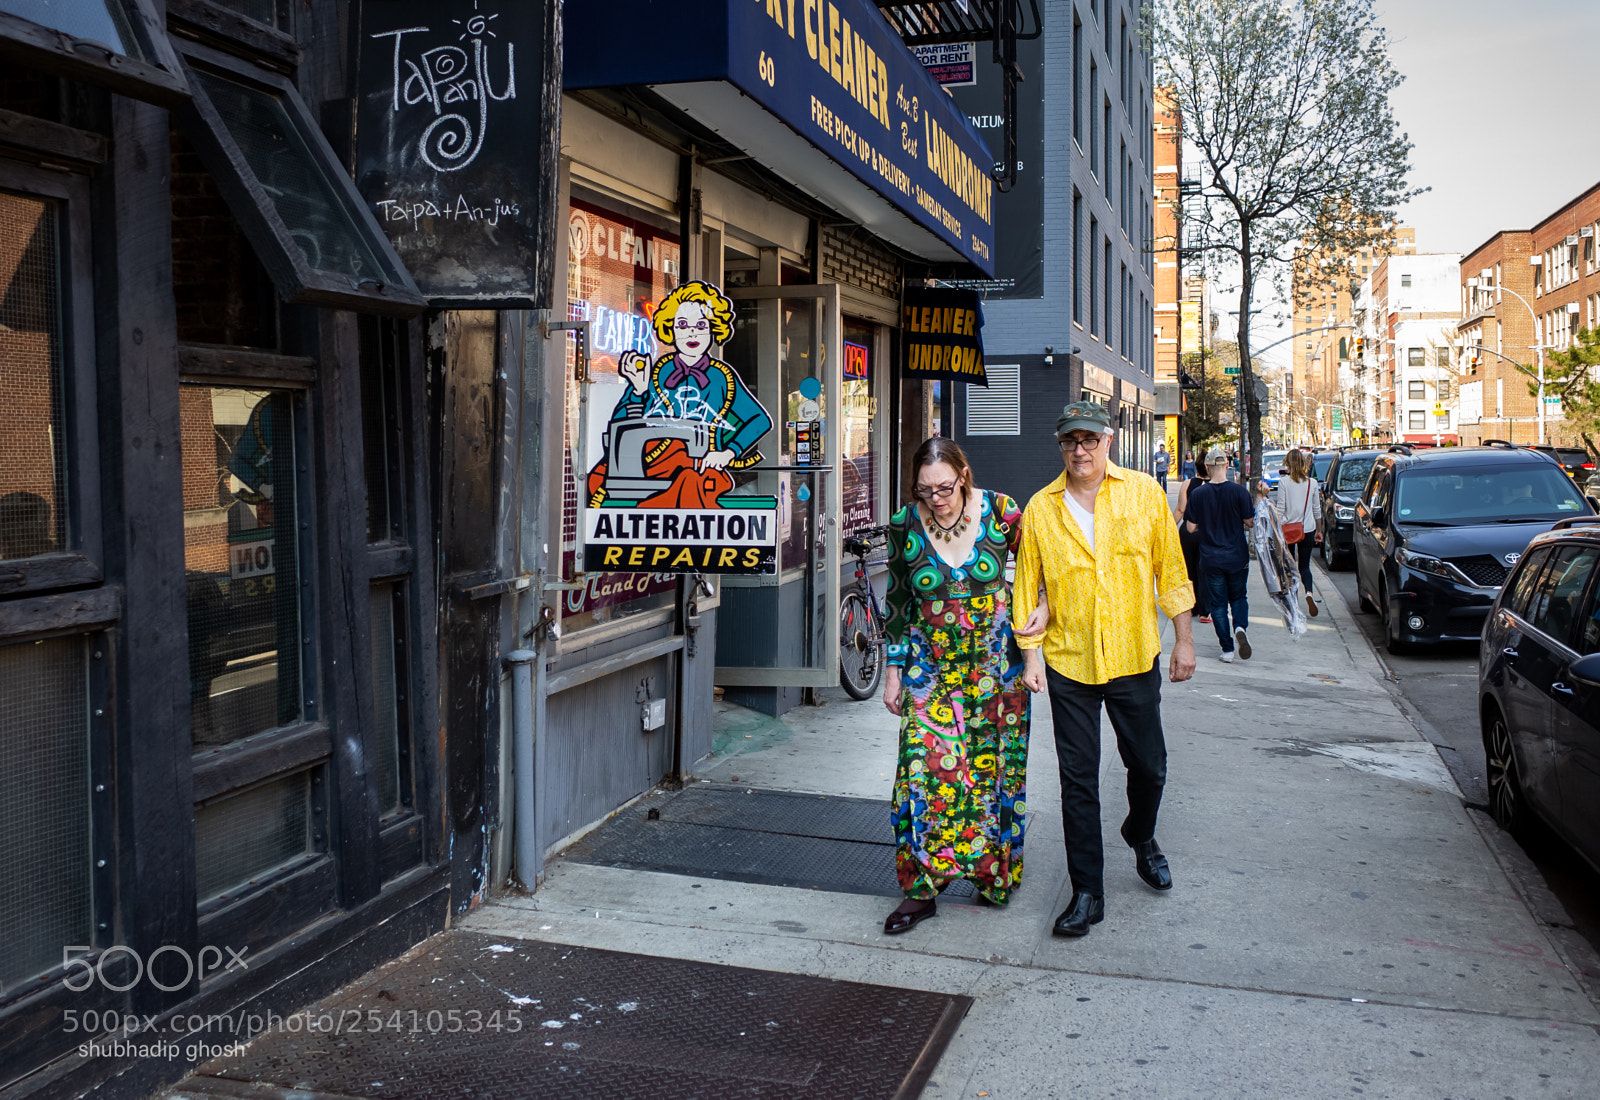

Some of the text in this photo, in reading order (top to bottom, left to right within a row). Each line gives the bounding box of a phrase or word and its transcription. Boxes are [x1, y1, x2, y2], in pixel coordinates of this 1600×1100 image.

[915, 43, 970, 55] APARTMENT
[940, 52, 970, 63] RENT
[758, 50, 775, 88] 60
[803, 0, 891, 131] CLEANER
[900, 121, 918, 160] Best
[810, 94, 962, 240] FREE PICK UP & DELIVERY SAMEDAY SERVICE
[924, 109, 992, 226] LAUNDROMAT
[904, 305, 977, 337] CLEANER
[845, 344, 867, 376] OPEN
[593, 513, 768, 541] ALTERATION
[603, 546, 762, 568] REPAIRS
